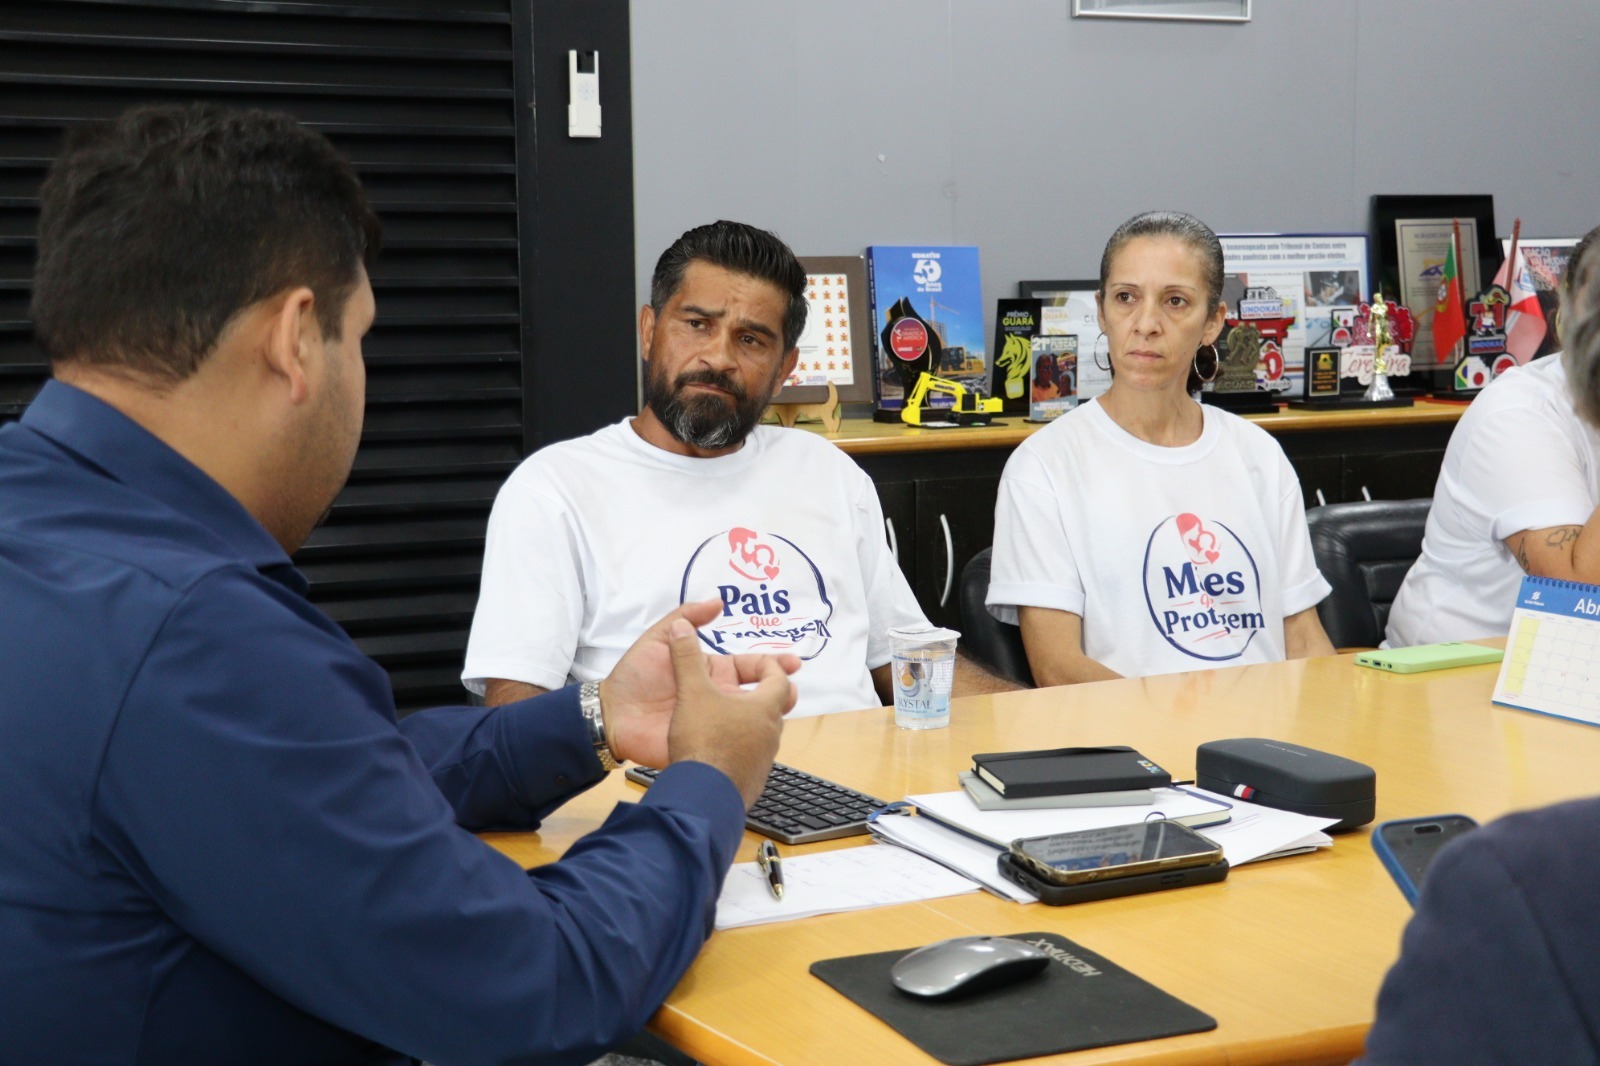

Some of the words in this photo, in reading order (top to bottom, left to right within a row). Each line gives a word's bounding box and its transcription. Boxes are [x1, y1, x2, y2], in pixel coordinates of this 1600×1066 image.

[913, 259, 942, 285] 50
[1002, 315, 1034, 326] GUARÁ
[1162, 561, 1245, 599] Mes
[717, 583, 791, 617] Pais
[749, 615, 782, 629] que
[1163, 607, 1265, 634] Protem
[896, 697, 933, 710] RYSTAL
